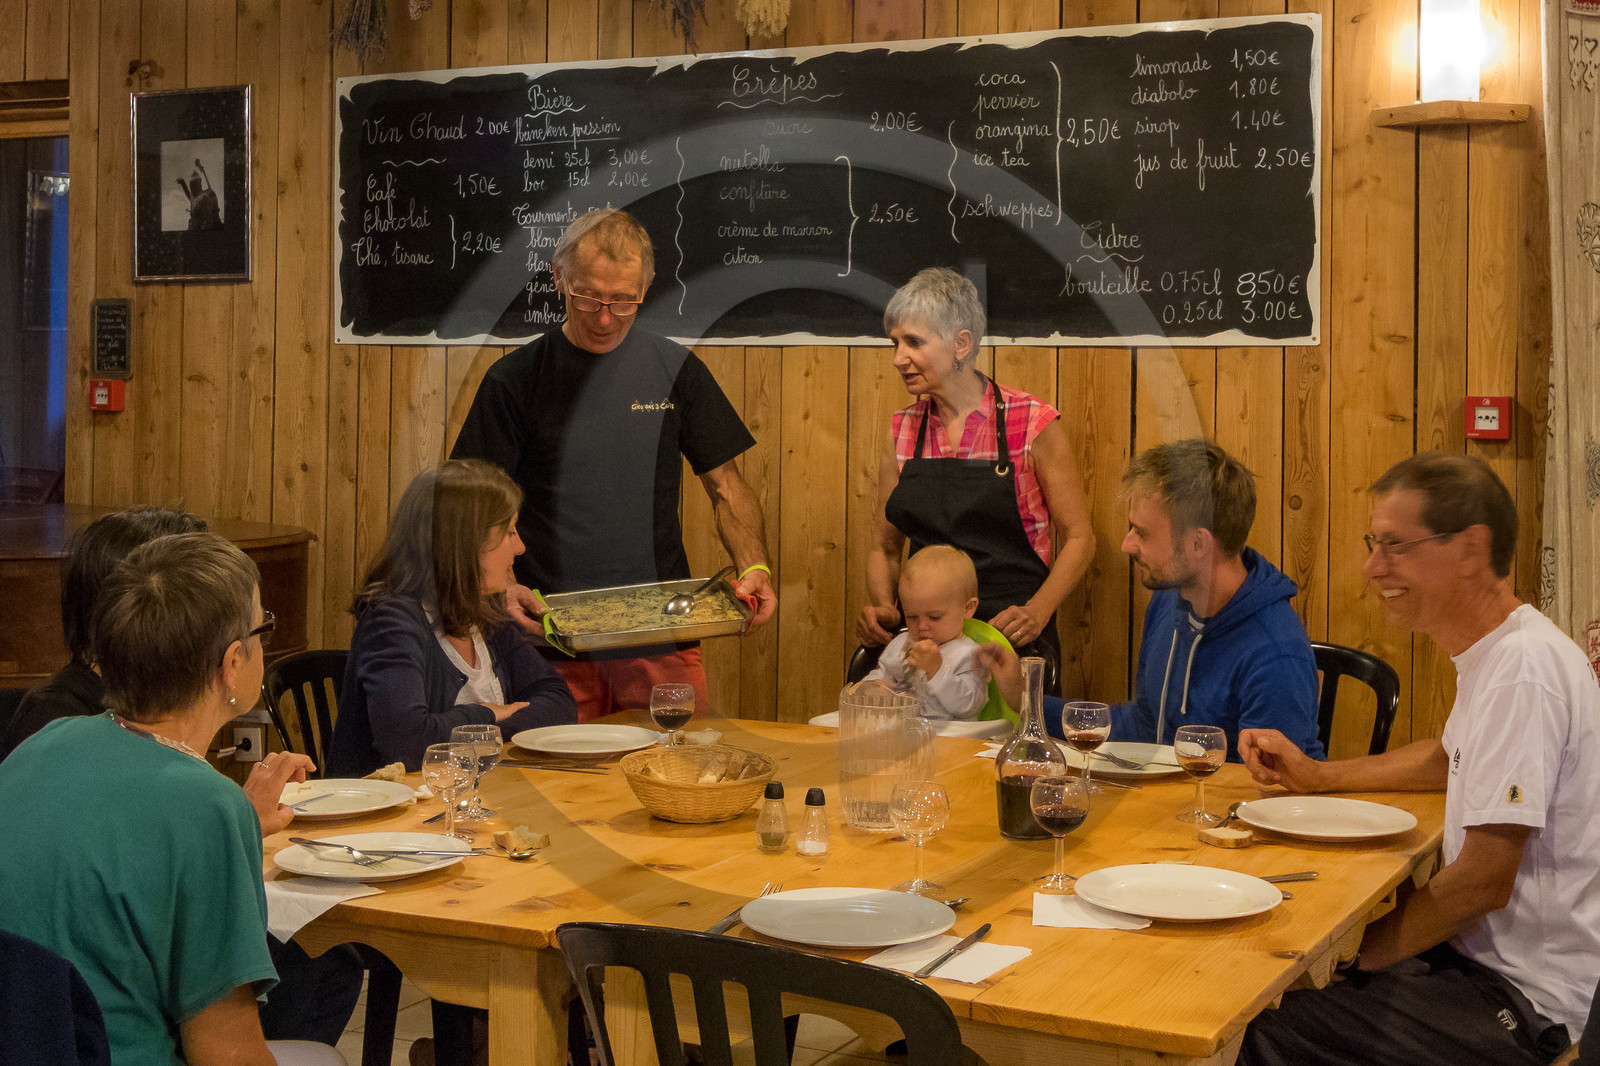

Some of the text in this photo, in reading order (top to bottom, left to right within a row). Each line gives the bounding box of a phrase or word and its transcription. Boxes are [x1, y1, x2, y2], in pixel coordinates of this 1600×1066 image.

[1129, 48, 1281, 78] limonade 1,50€
[975, 73, 1026, 87] coca
[1131, 79, 1199, 105] diabolo
[527, 84, 574, 111] Bière
[971, 94, 1041, 120] perrier
[362, 116, 404, 144] Vin
[410, 112, 468, 141] Chaud
[570, 117, 621, 150] pression
[869, 111, 924, 132] 2,00€
[1066, 118, 1121, 147] 2,50€
[1134, 116, 1181, 148] sirop
[975, 117, 1054, 153] orangina
[523, 147, 653, 169] demi 25cl 3,00€
[719, 144, 786, 173] nutella
[972, 148, 1030, 166] ice tea
[1133, 144, 1161, 189] jus
[1170, 147, 1189, 170] de
[1195, 138, 1242, 191] fruit
[567, 166, 591, 187] 15cl
[606, 170, 652, 188] 2,00€
[366, 172, 503, 220] Café 1,50€
[719, 180, 791, 212] confiture
[363, 198, 431, 234] Chocolat
[512, 200, 578, 226] Tourmente
[868, 202, 920, 224] 2,50€
[961, 193, 1053, 229] schweppes
[718, 220, 833, 238] crème de marron
[1080, 220, 1142, 249] Cidre
[391, 240, 435, 266] tisane
[461, 230, 503, 255] 2,20€
[723, 246, 763, 265] citron
[525, 250, 554, 273] blan
[1059, 263, 1153, 297] bouteille
[1236, 268, 1301, 298] 8,50€
[524, 301, 568, 325] ambré
